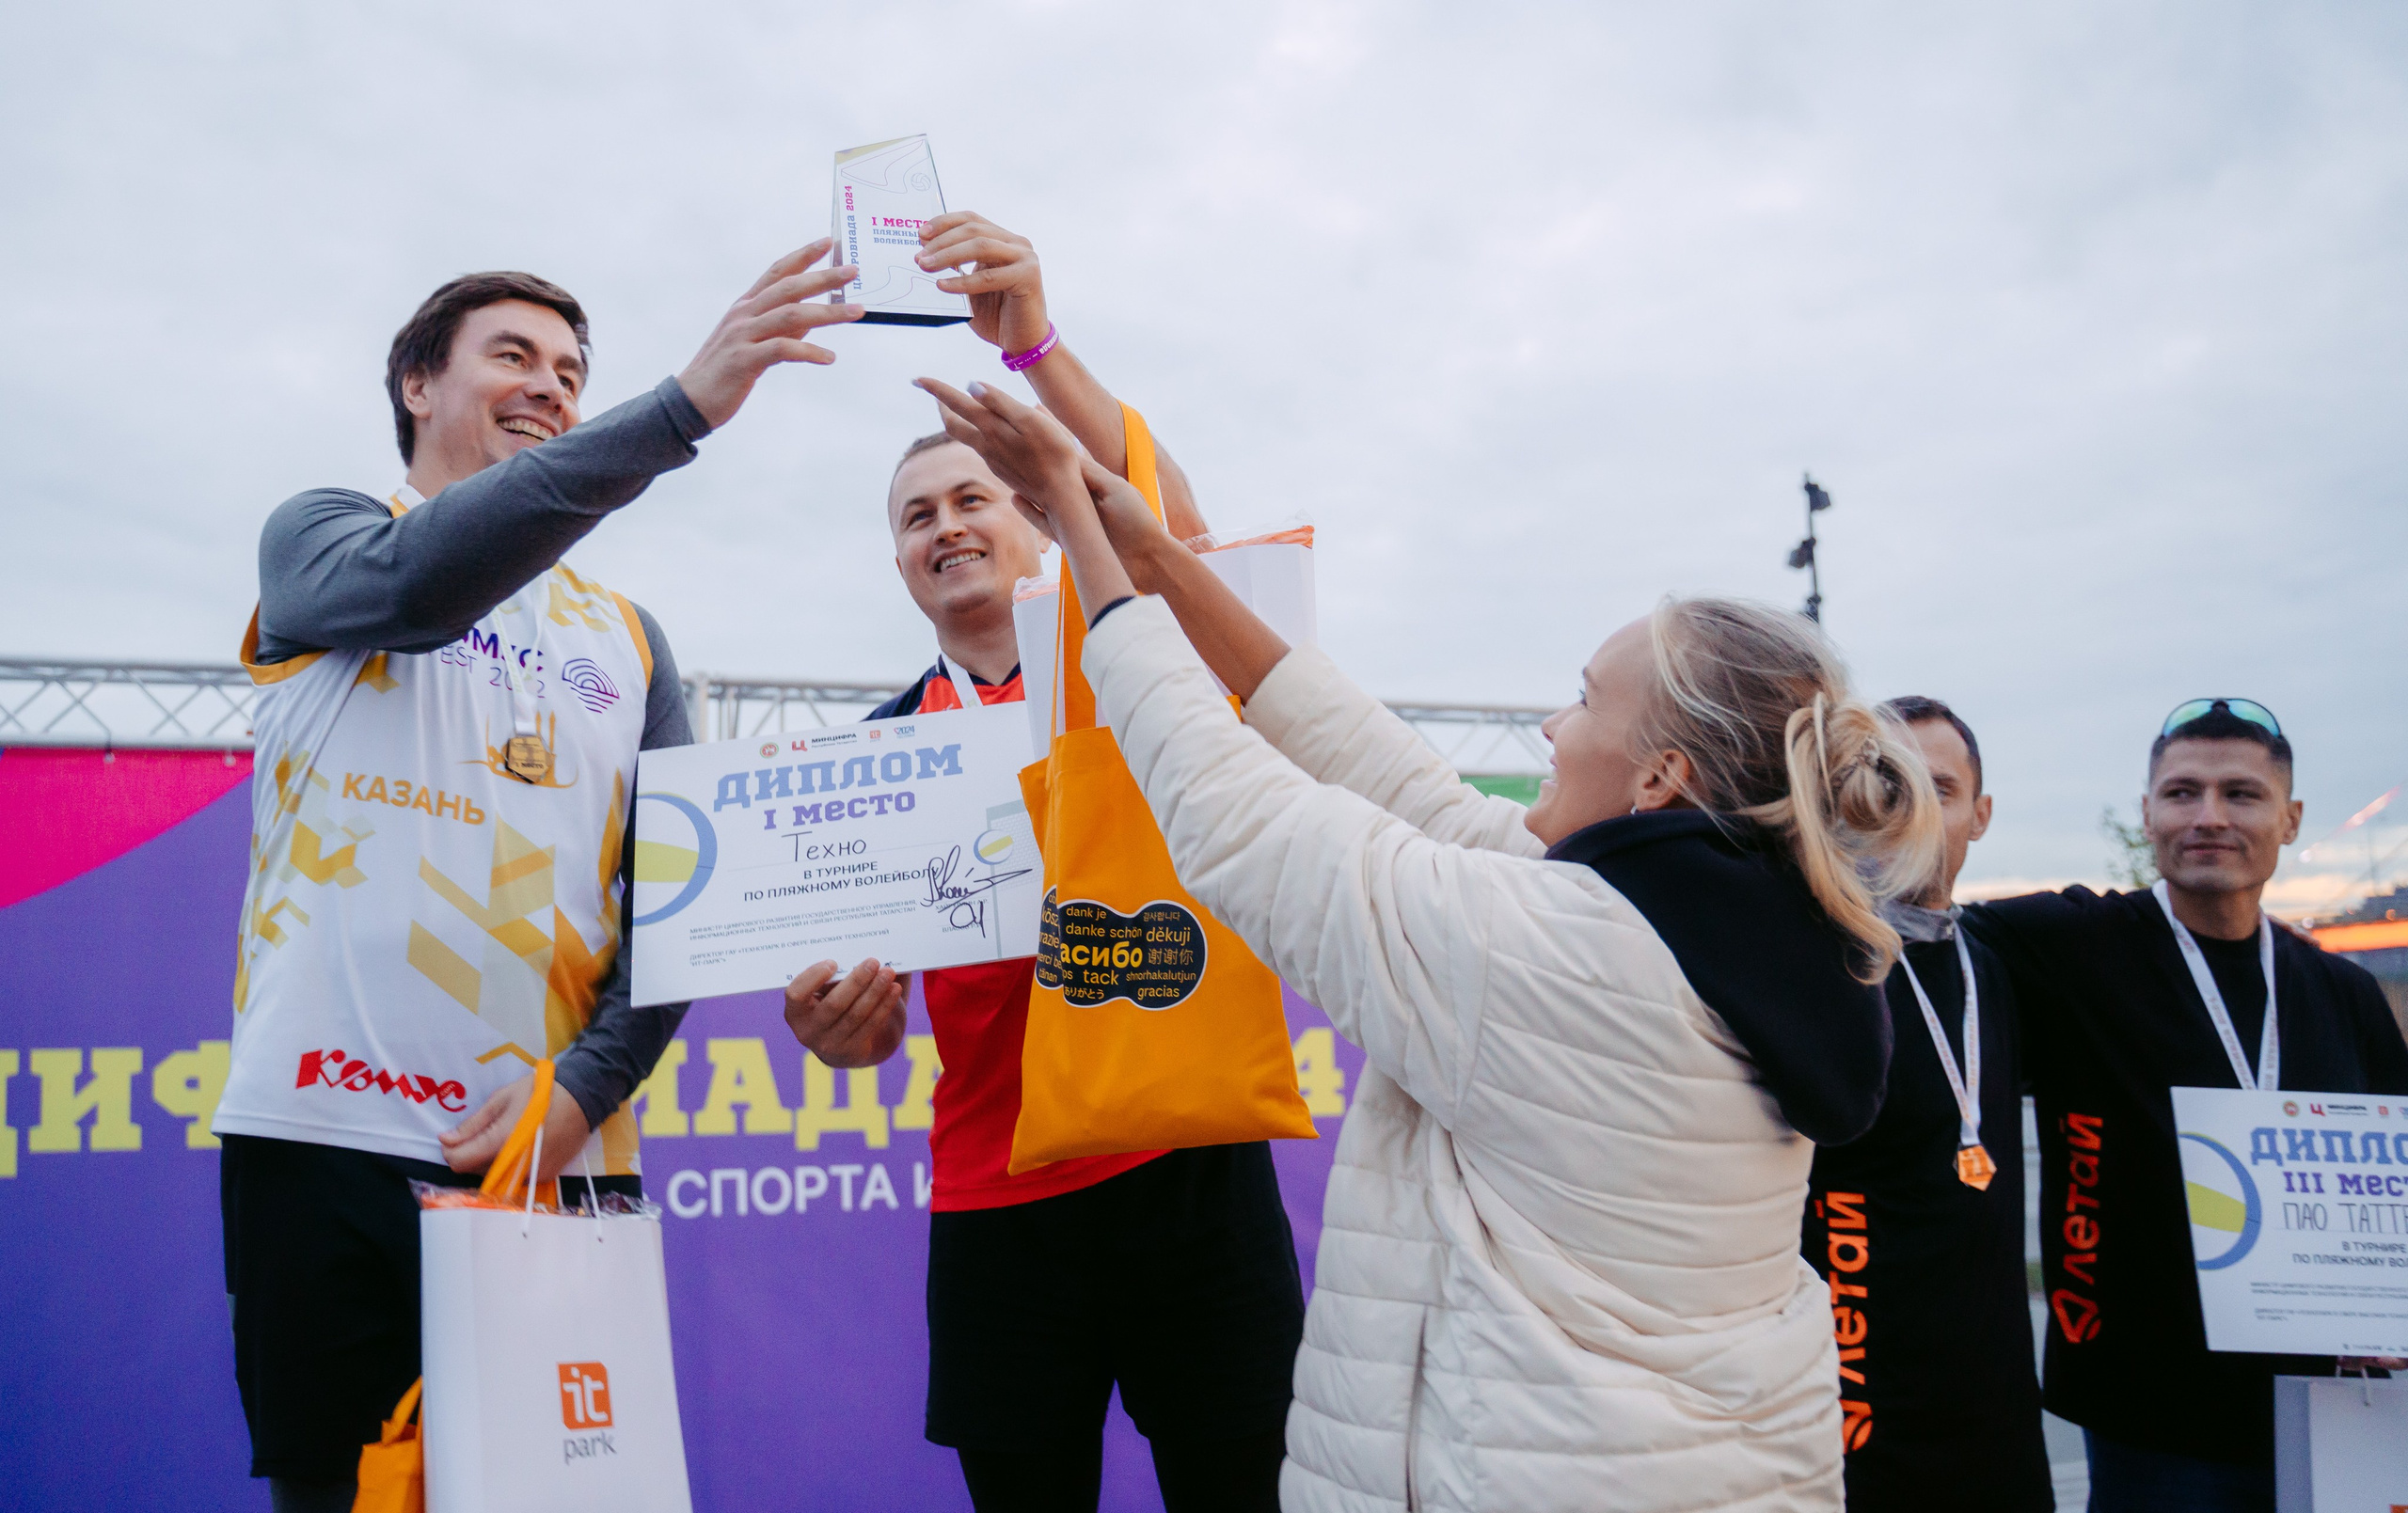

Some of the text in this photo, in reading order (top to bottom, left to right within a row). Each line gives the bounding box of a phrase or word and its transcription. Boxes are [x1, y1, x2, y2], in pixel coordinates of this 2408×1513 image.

[845, 185, 854, 211] 2024
[812, 733, 857, 743] МИНЦИФРА
[713, 744, 963, 812] ДИПЛОМ
[342, 772, 485, 826] КАЗАНЬ
[782, 831, 867, 862] Техно
[803, 861, 878, 879] В ТУРНИРЕ
[744, 866, 939, 902] ПО ПЛЯЖНОМУ ВОЛЕЙБОЛУ
[801, 906, 871, 919] ГОСУДАРСТВЕННОГО
[833, 911, 878, 922] РЕСПУБЛИКИ
[880, 906, 915, 916] ТАТАРСТАН
[1066, 906, 1106, 924] dank je
[1143, 911, 1180, 922] 감사합니다
[1066, 923, 1142, 938] danke schön
[1146, 926, 1191, 946] děkuji
[1039, 931, 1059, 949] razie
[1060, 941, 1144, 969] асибо
[1149, 947, 1194, 965] 谢谢你
[1038, 968, 1057, 984] tänan
[1084, 969, 1119, 985] tack
[1064, 985, 1104, 1000] ありがとう
[1137, 985, 1180, 1001] gracias
[667, 1162, 899, 1219] СПОРТА
[2282, 1202, 2328, 1231] ПАО
[562, 1365, 609, 1423] it
[563, 1429, 617, 1466] park
